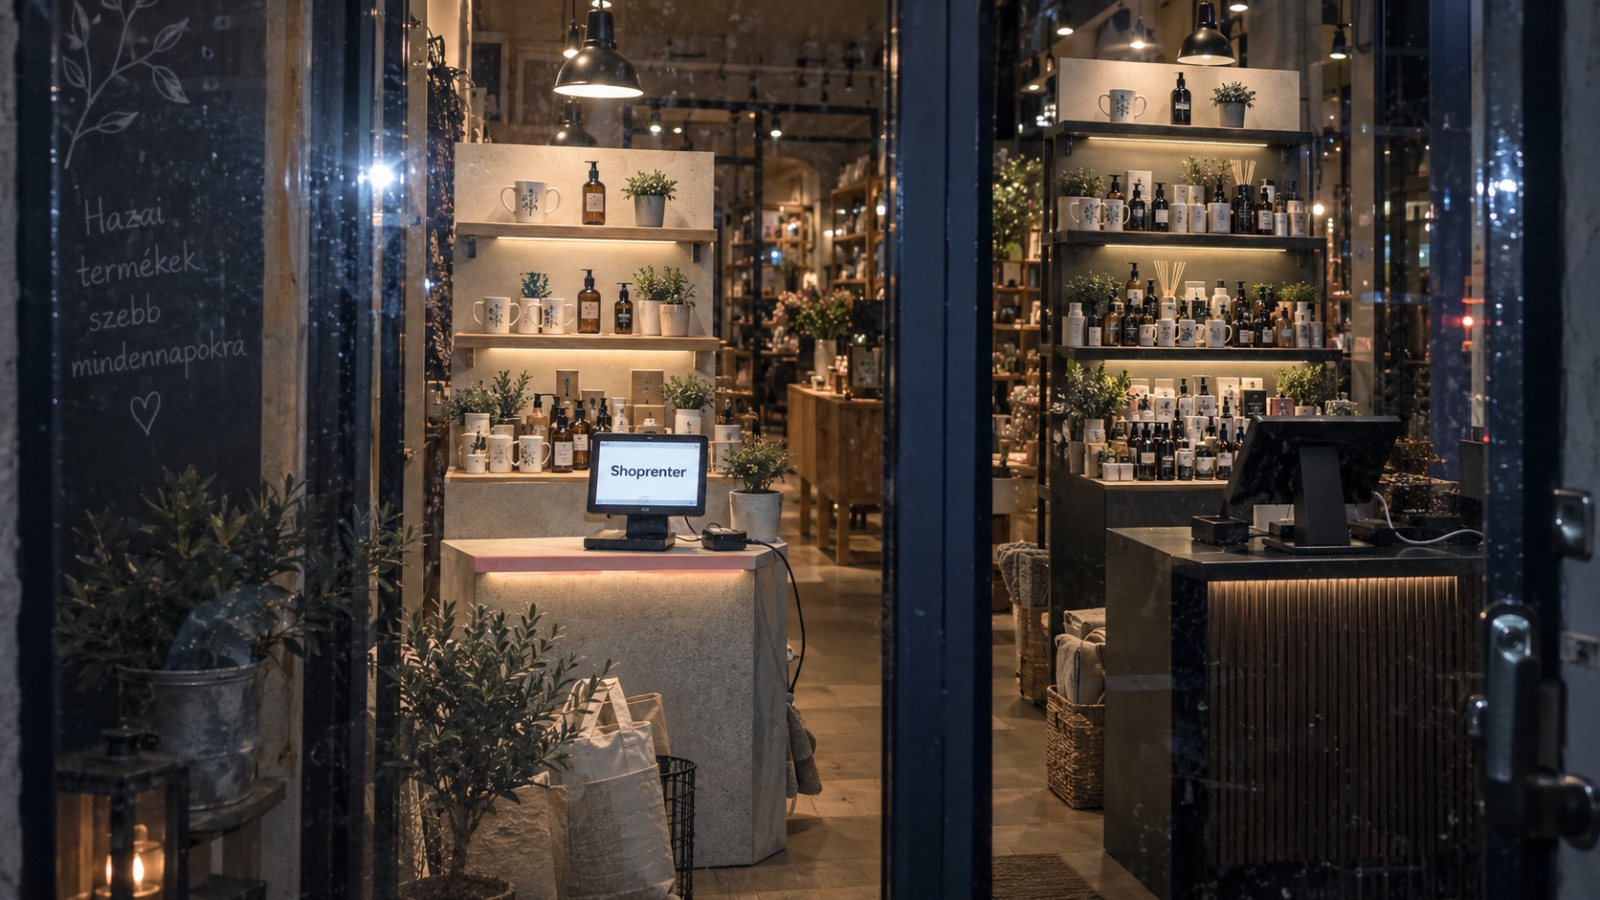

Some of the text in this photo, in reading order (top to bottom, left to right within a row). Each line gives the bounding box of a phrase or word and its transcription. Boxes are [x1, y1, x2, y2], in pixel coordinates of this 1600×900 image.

[84, 196, 165, 236] Hazai
[76, 240, 200, 286] termékek
[89, 293, 161, 331] szebb
[72, 329, 247, 379] mindennapokra
[610, 464, 687, 479] Shoprenter
